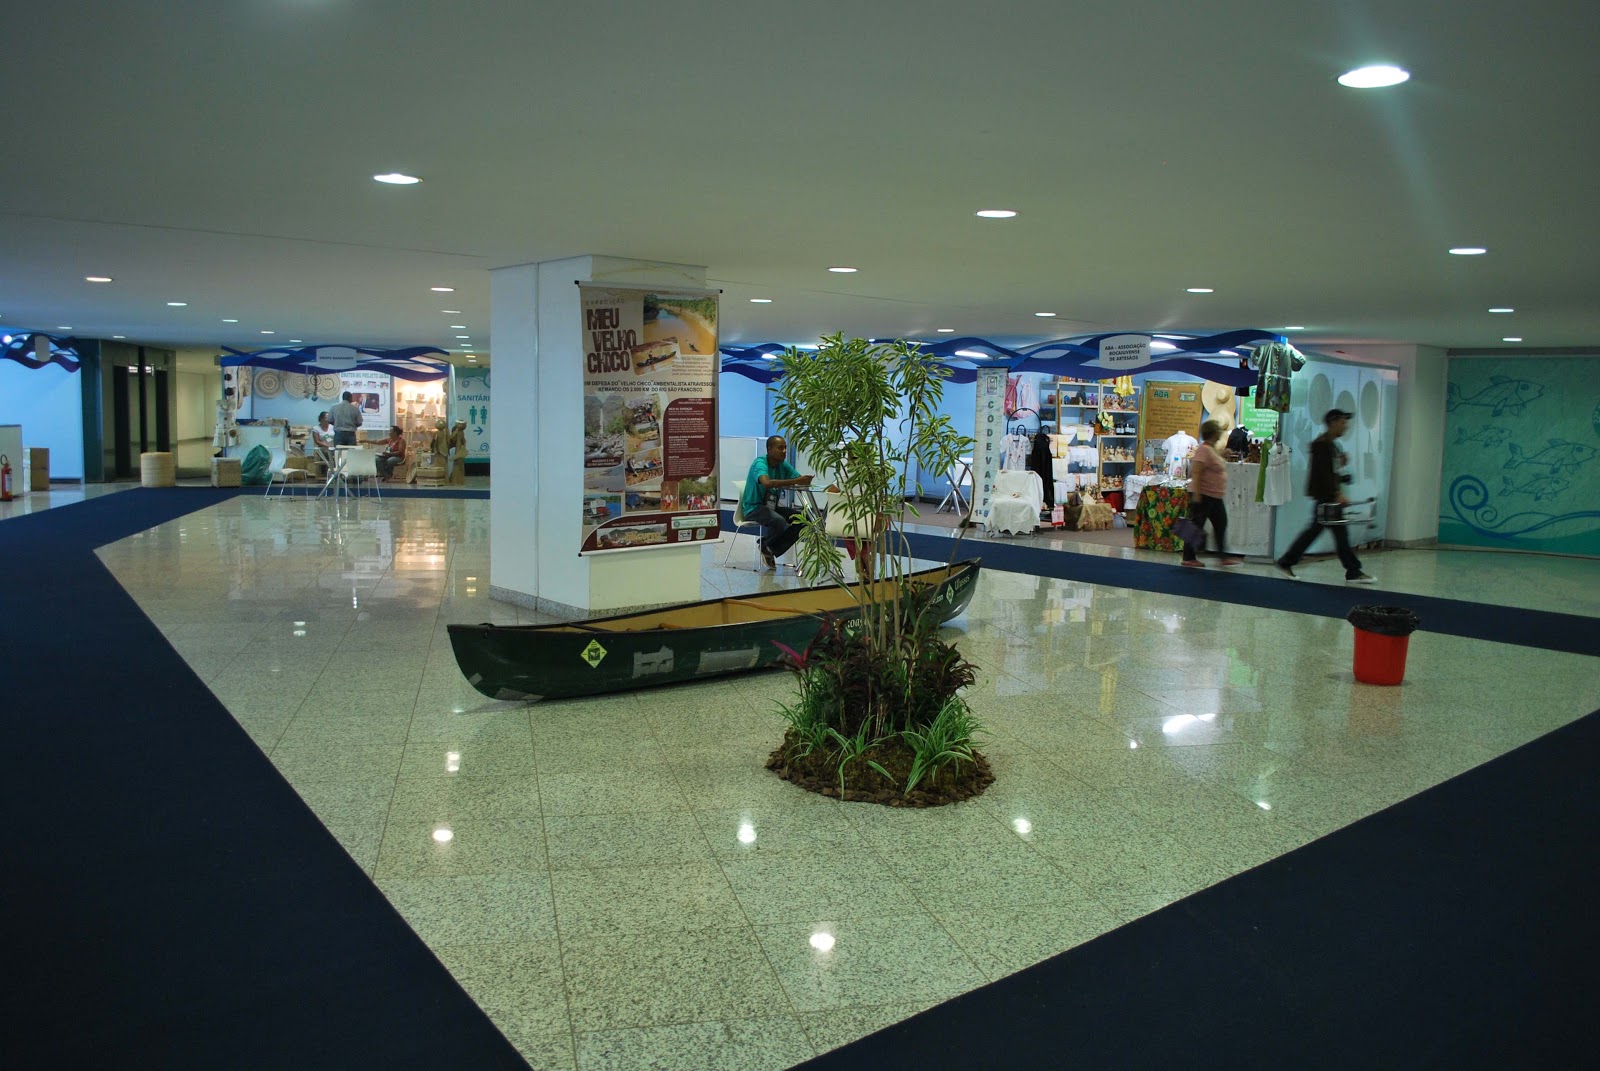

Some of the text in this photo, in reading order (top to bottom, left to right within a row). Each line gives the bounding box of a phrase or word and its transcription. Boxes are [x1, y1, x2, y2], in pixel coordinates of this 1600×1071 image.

[586, 308, 619, 330] MEU
[592, 329, 637, 352] VELHO
[1118, 342, 1146, 350] ASSOCIAÇÃO
[586, 351, 630, 374] CHICO
[1153, 391, 1169, 399] ABA
[982, 400, 995, 506] CODEVASF
